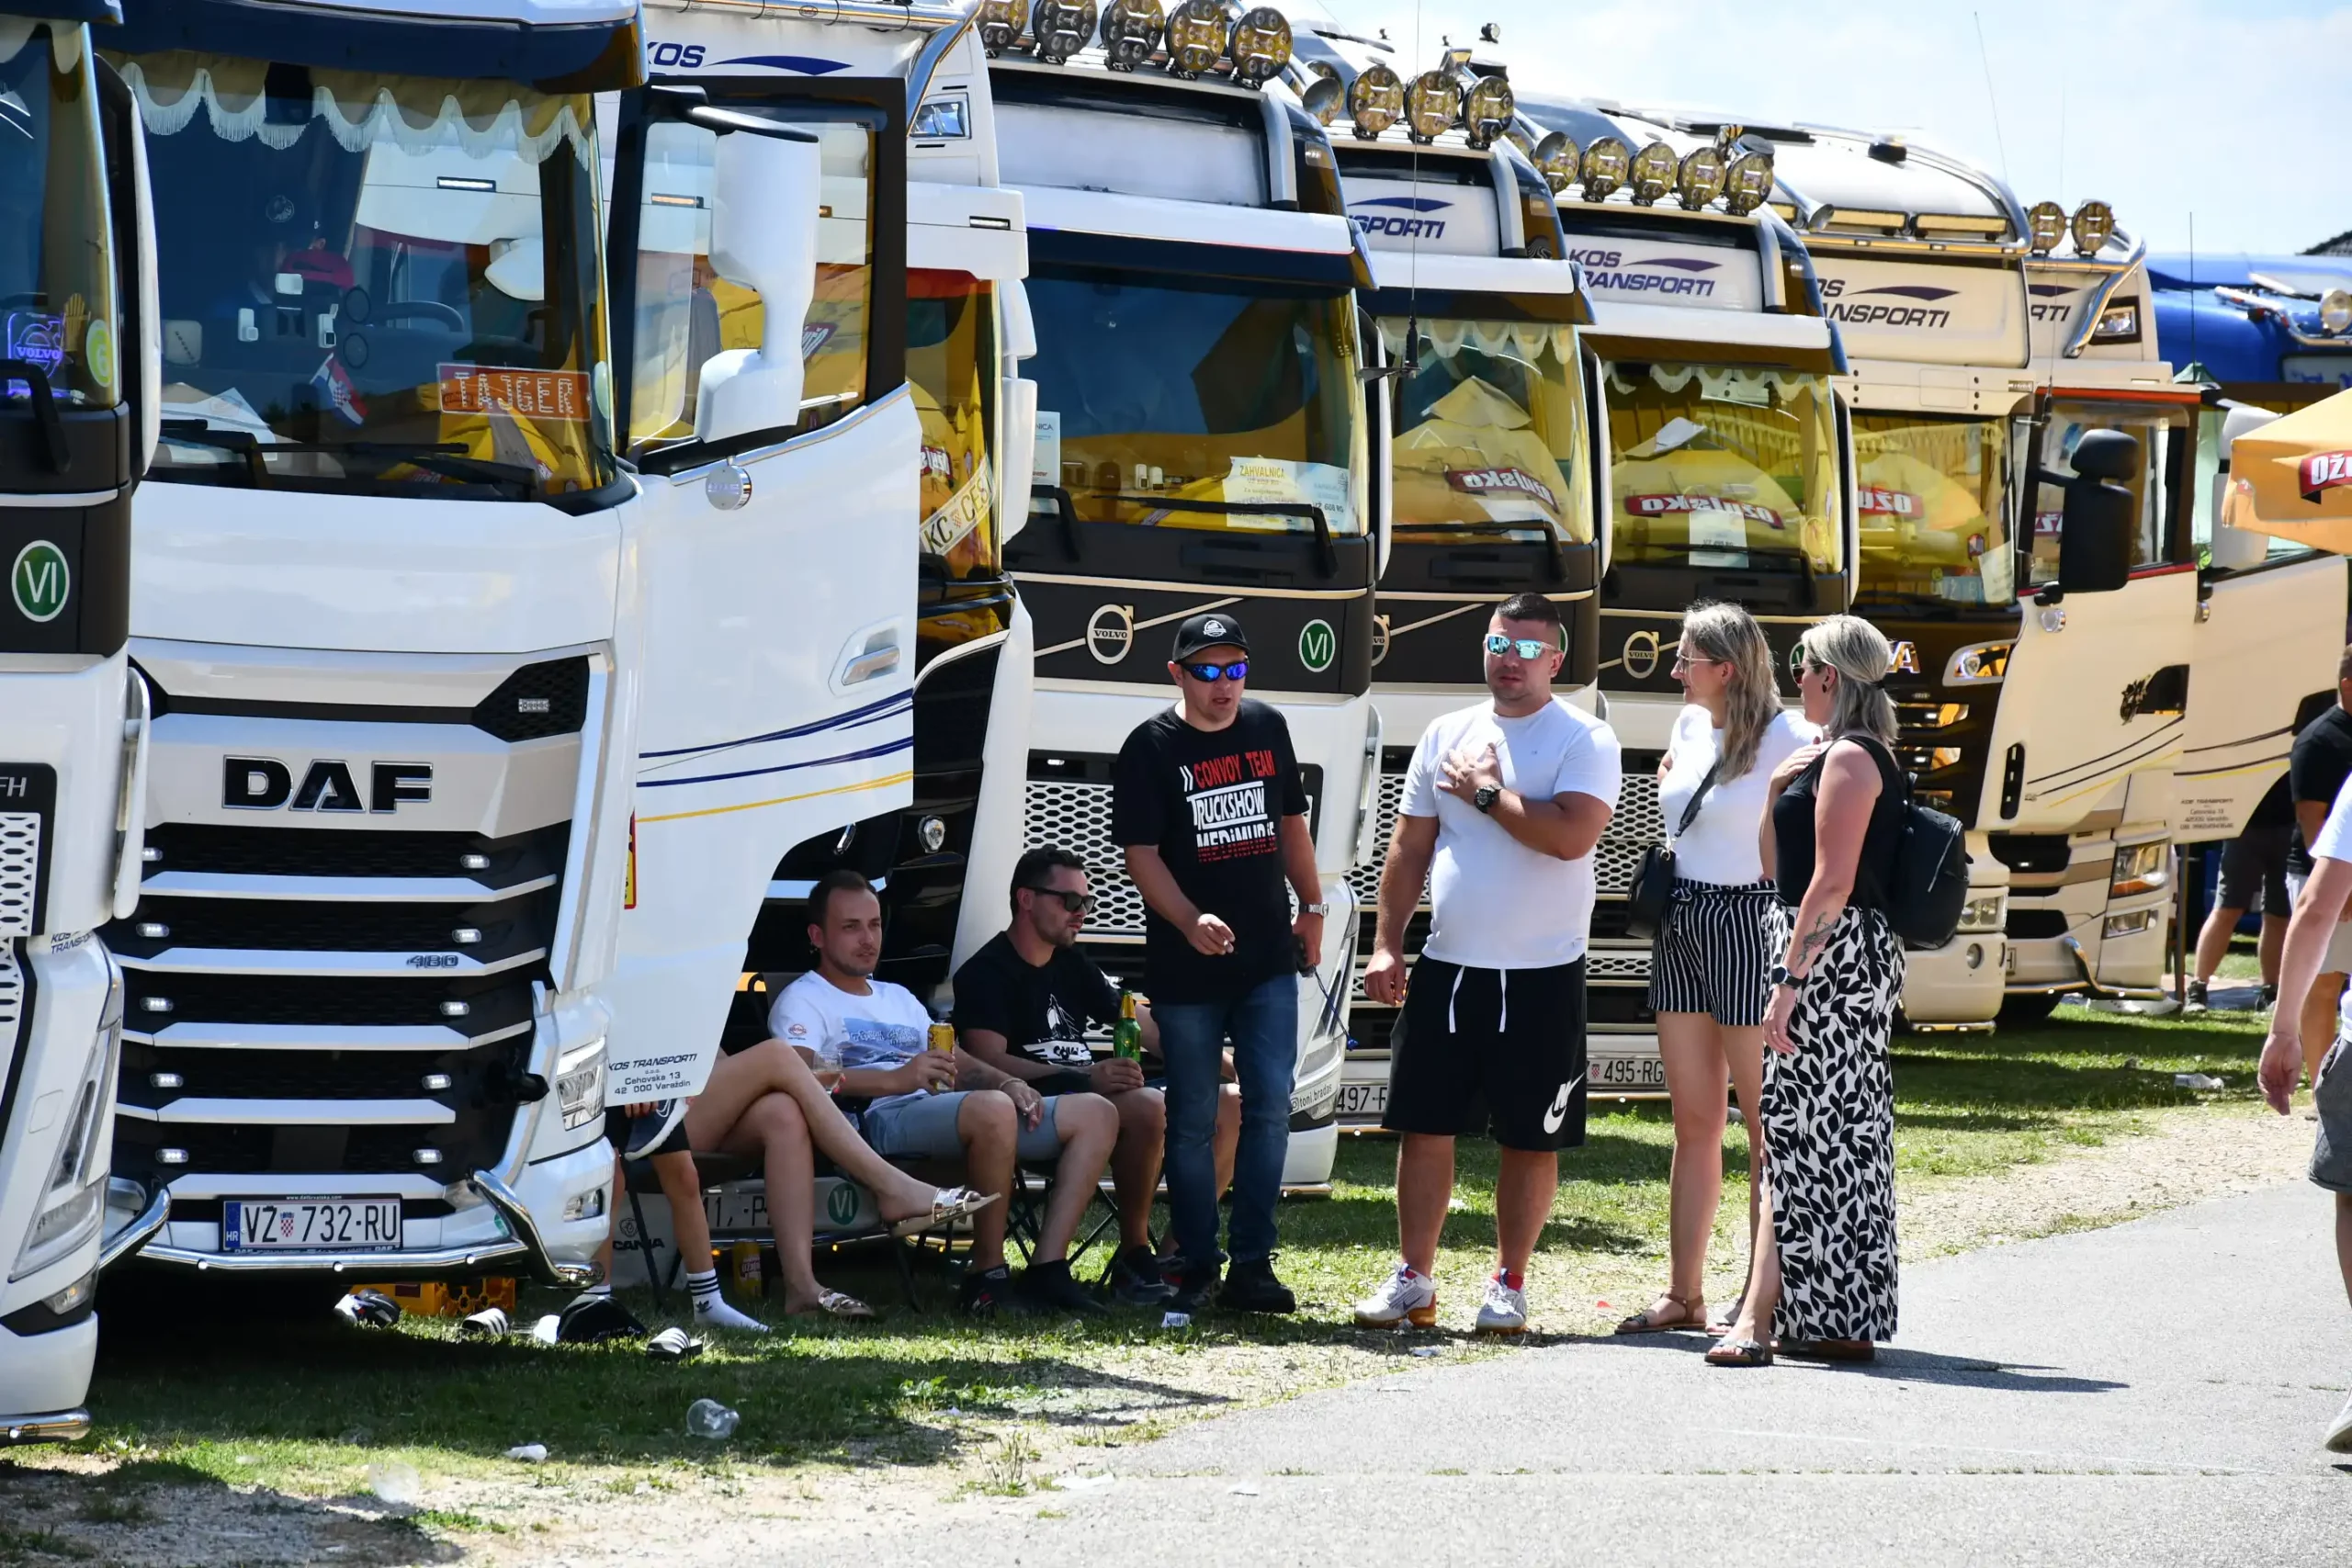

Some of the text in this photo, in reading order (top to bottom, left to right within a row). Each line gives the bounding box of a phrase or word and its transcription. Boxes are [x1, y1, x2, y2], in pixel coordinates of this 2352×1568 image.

[1351, 215, 1446, 239] SPORTI
[1568, 249, 1622, 267] KOS
[1582, 271, 1715, 296] RANSPORTI
[17, 346, 63, 360] VOLVO
[1240, 465, 1285, 479] ZAHVALNICA
[923, 515, 954, 554] KC
[23, 560, 57, 604] VI
[1093, 629, 1128, 639] VOLVO
[1306, 631, 1329, 661] VI
[1193, 750, 1276, 789] CONVOY TEAM
[221, 754, 433, 814] DAF
[1186, 781, 1268, 830] TRUCKSHOW
[406, 954, 458, 968] 480
[608, 1053, 697, 1071] KOS TRANSPORTI
[669, 1071, 681, 1080] 13
[614, 1087, 628, 1095] 42
[633, 1084, 652, 1093] 000
[832, 1189, 854, 1219] VI
[226, 1230, 239, 1242] HR
